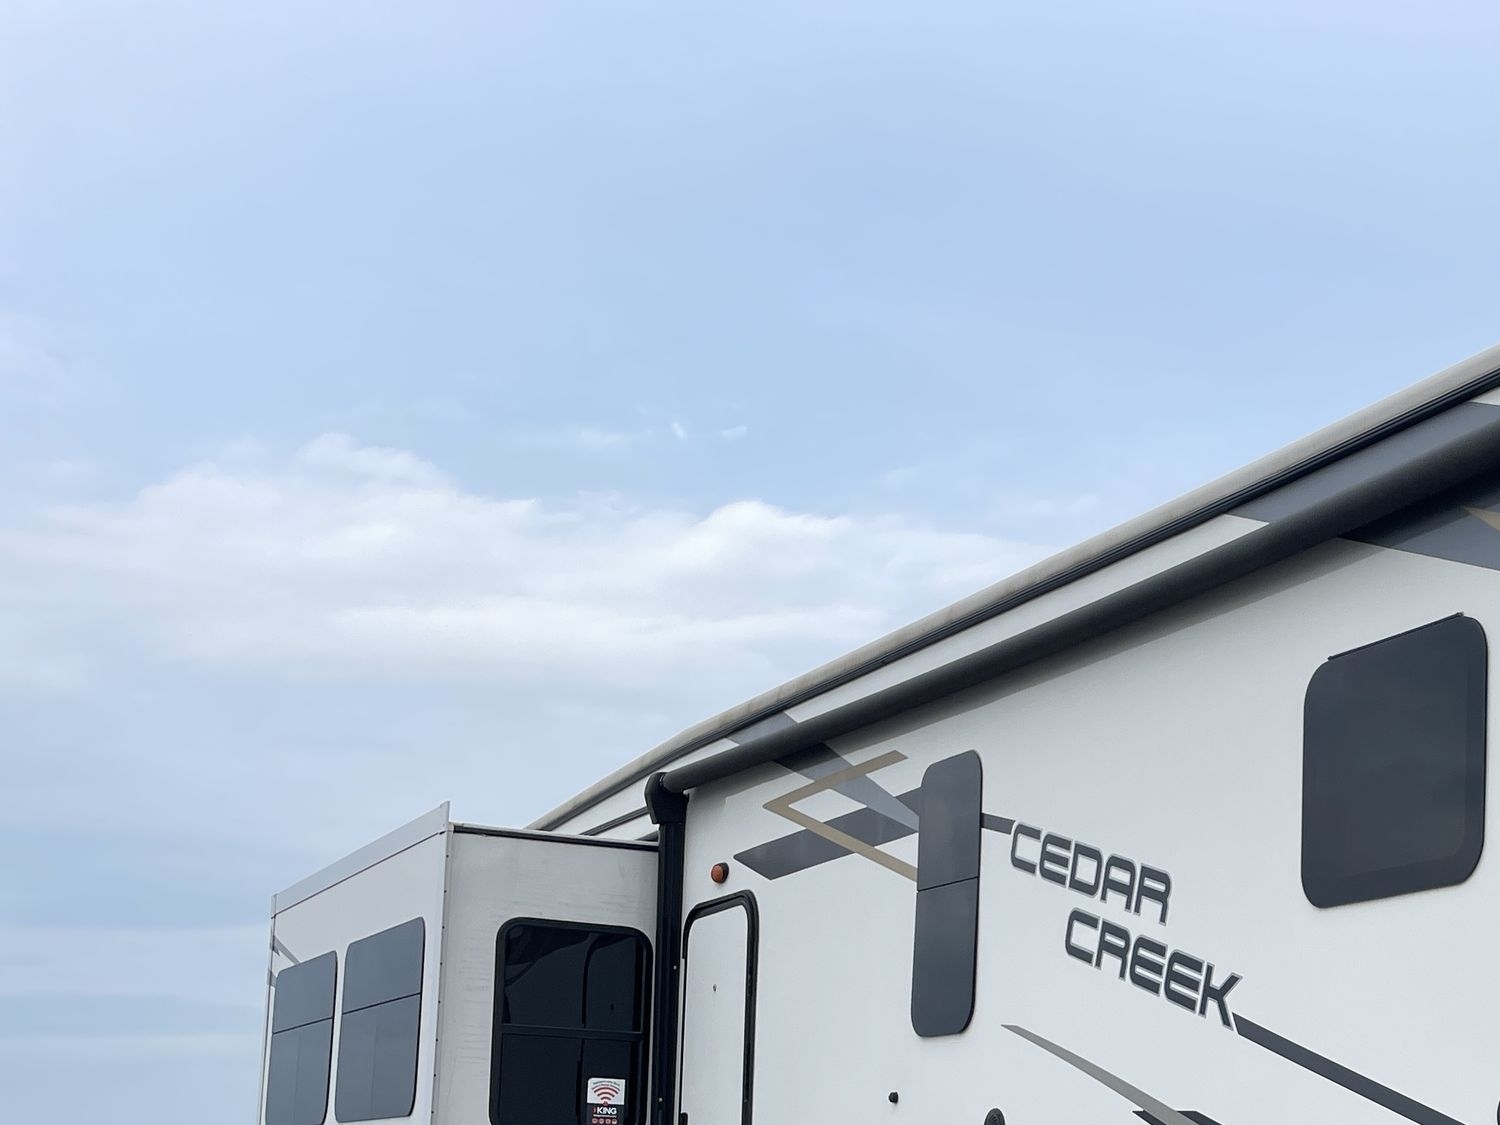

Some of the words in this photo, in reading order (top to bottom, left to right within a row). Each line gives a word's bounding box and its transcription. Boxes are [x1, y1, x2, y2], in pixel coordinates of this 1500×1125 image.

[1010, 821, 1172, 927] CEDAR
[1065, 906, 1244, 1032] CREEK
[596, 1106, 617, 1115] KING
